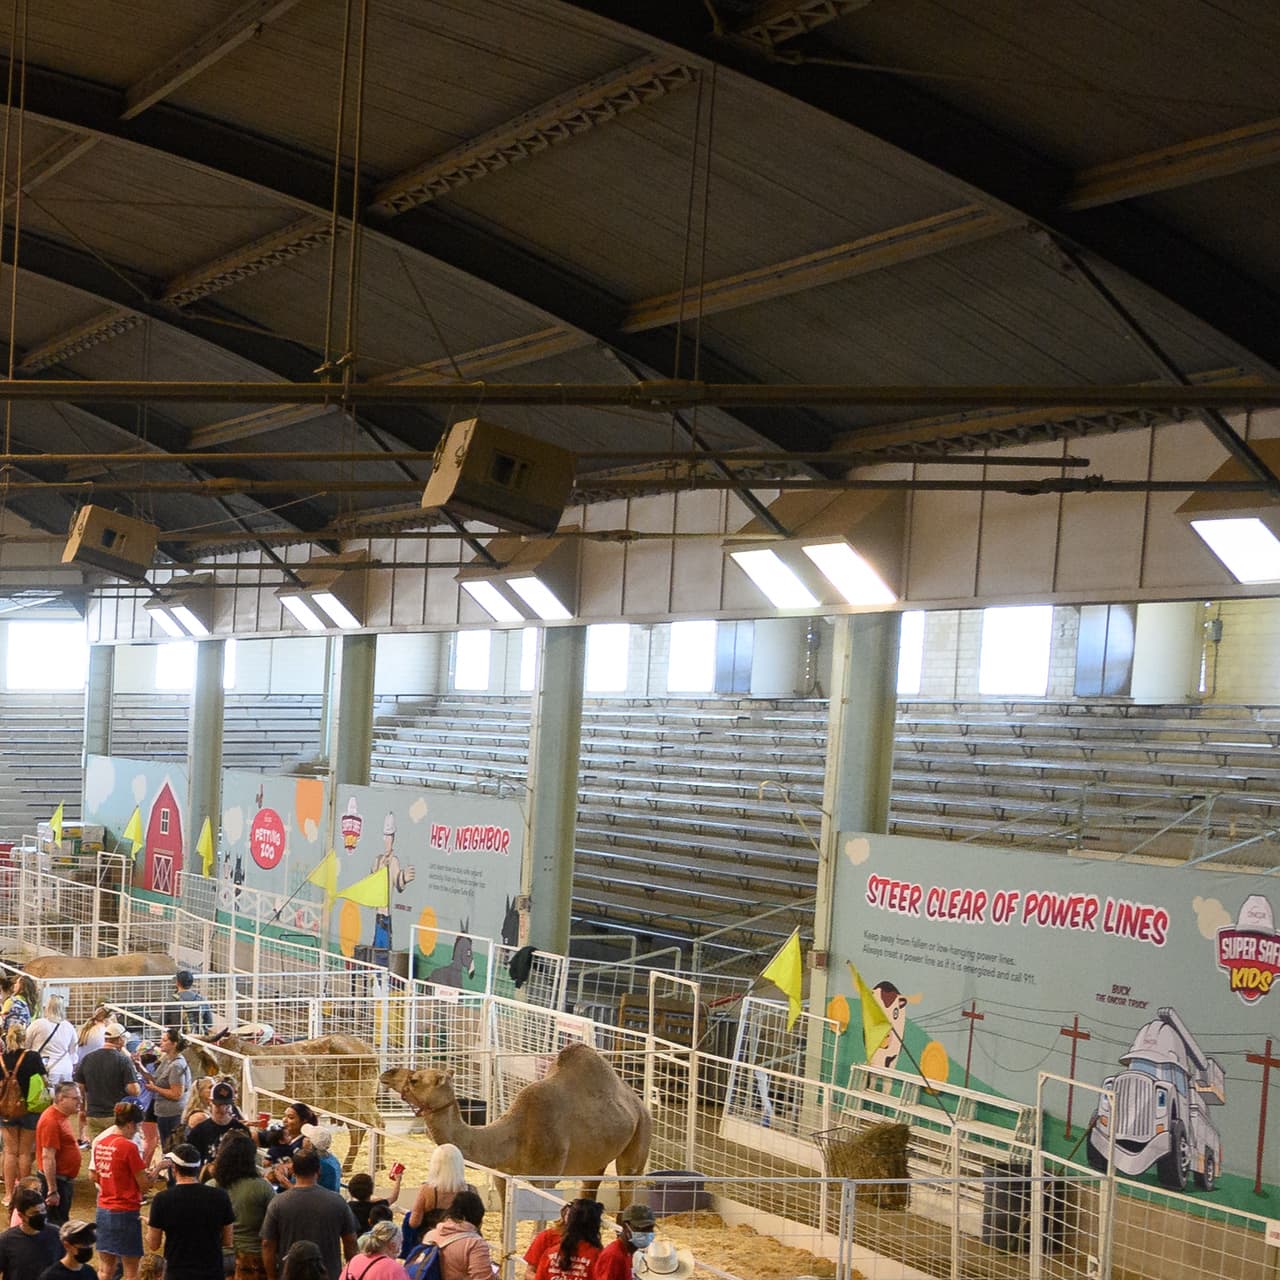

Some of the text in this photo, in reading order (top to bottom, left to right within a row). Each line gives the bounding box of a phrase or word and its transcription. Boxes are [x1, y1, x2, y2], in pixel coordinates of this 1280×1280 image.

[255, 828, 281, 846] PETTING
[430, 824, 510, 855] HEY, NEIGHBOR
[260, 844, 275, 859] ZOO
[866, 874, 1170, 946] STEER CLEAR OF POWER LINES
[1221, 937, 1257, 960] SUPER
[1231, 967, 1273, 992] KIDS
